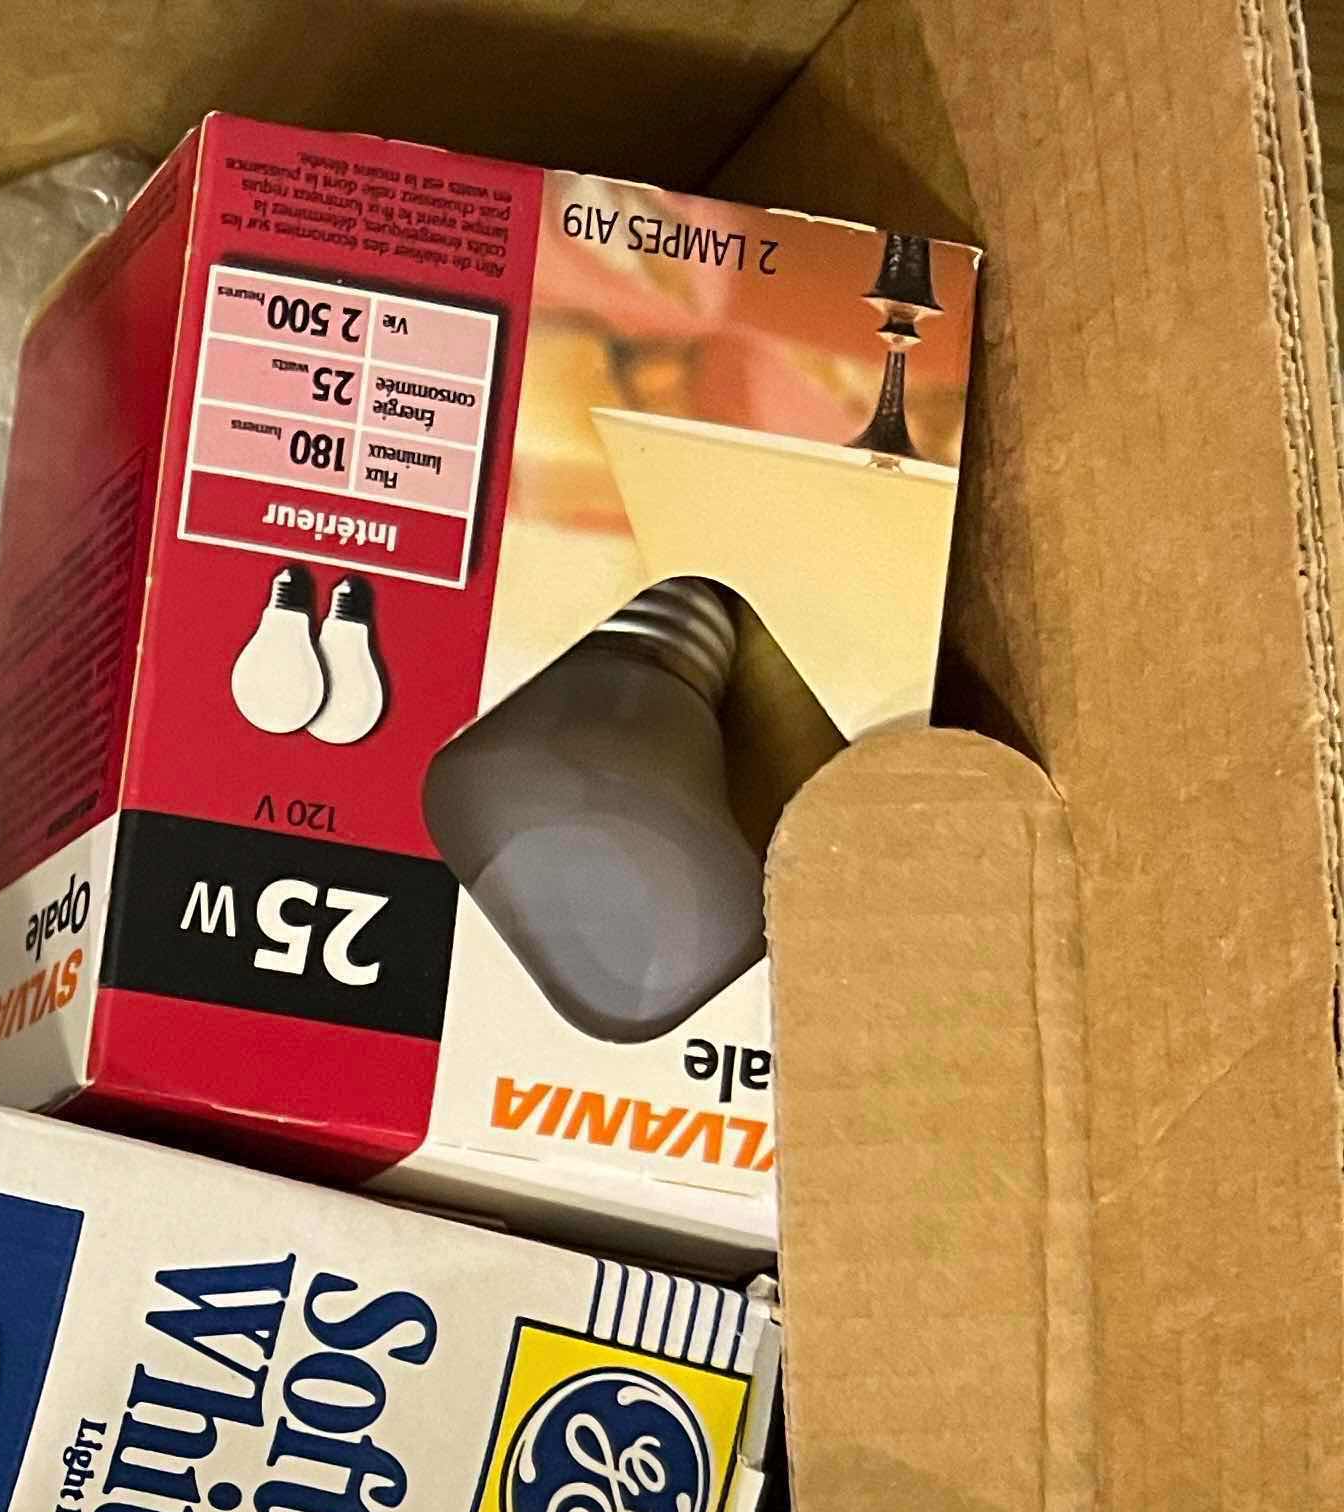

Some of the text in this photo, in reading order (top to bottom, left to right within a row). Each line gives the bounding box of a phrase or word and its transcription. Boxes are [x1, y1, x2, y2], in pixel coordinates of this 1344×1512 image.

[563, 203, 779, 275] 2 LAMPES A19
[216, 284, 409, 343] Vie 2 500 heures
[309, 365, 356, 406] 25
[371, 395, 436, 430] Énergie
[373, 376, 476, 410] consommée
[229, 417, 442, 473] lumineux 180 lumens
[363, 466, 398, 488] Flux
[260, 501, 399, 552] Intérieur
[255, 795, 338, 831] 120 V
[25, 873, 92, 962] Opale
[254, 878, 390, 988] 25
[684, 1037, 769, 1103] ale
[492, 1077, 775, 1173] LVANIA
[62, 1419, 106, 1505] Light
